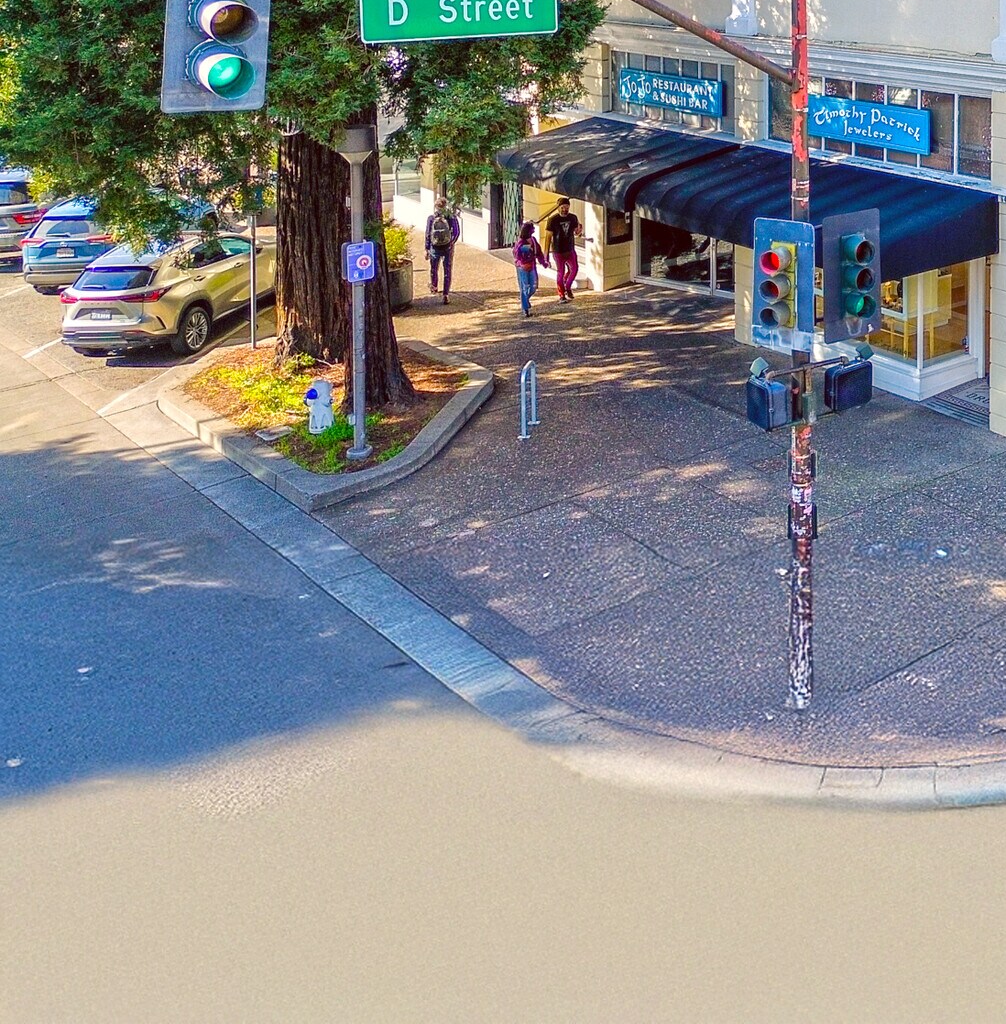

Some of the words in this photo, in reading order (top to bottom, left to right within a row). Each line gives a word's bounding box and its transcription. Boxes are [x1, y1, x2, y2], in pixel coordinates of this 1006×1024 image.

[652, 78, 714, 96] RESTAURANT
[652, 91, 659, 101] &
[660, 92, 687, 107] SUSHI
[688, 98, 708, 110] BAR
[813, 106, 867, 125] Timothy
[870, 108, 921, 142] Patrick
[843, 121, 893, 141] Jewelers
